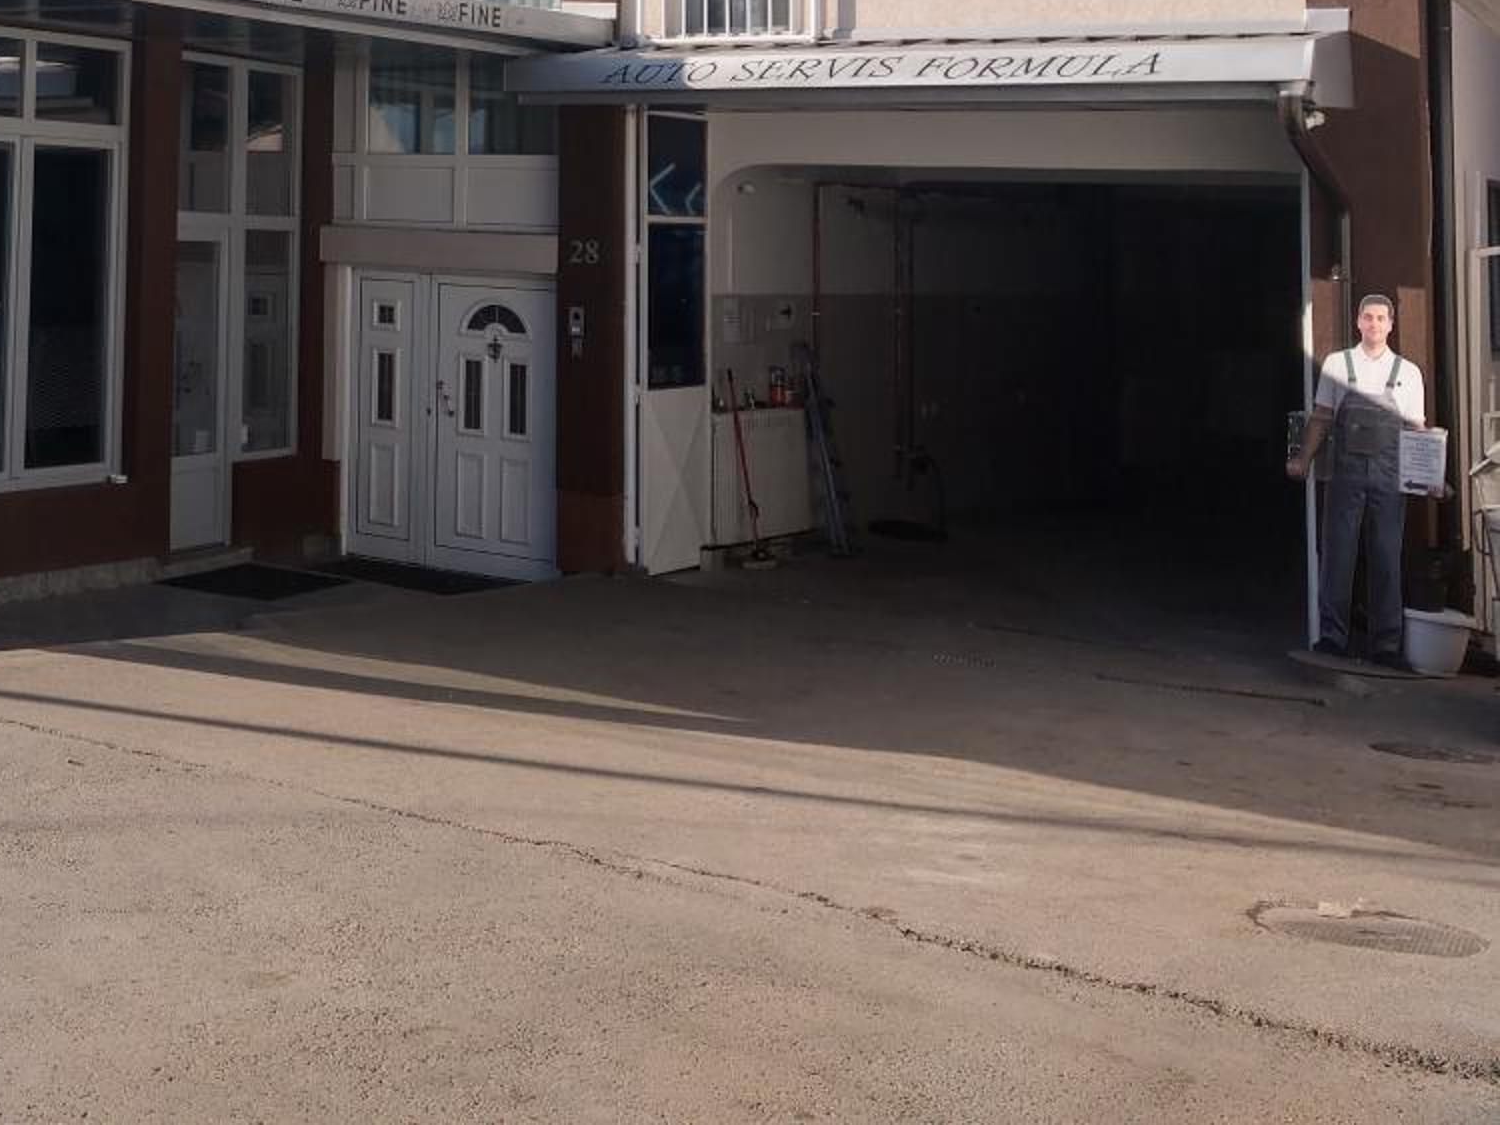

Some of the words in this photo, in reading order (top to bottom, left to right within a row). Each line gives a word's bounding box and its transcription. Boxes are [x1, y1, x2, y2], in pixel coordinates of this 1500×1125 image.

[459, 2, 501, 27] FINE
[602, 61, 718, 85] AUTO
[730, 55, 904, 82] SERVIS
[913, 52, 1163, 80] FORMULA
[569, 238, 599, 264] 28
